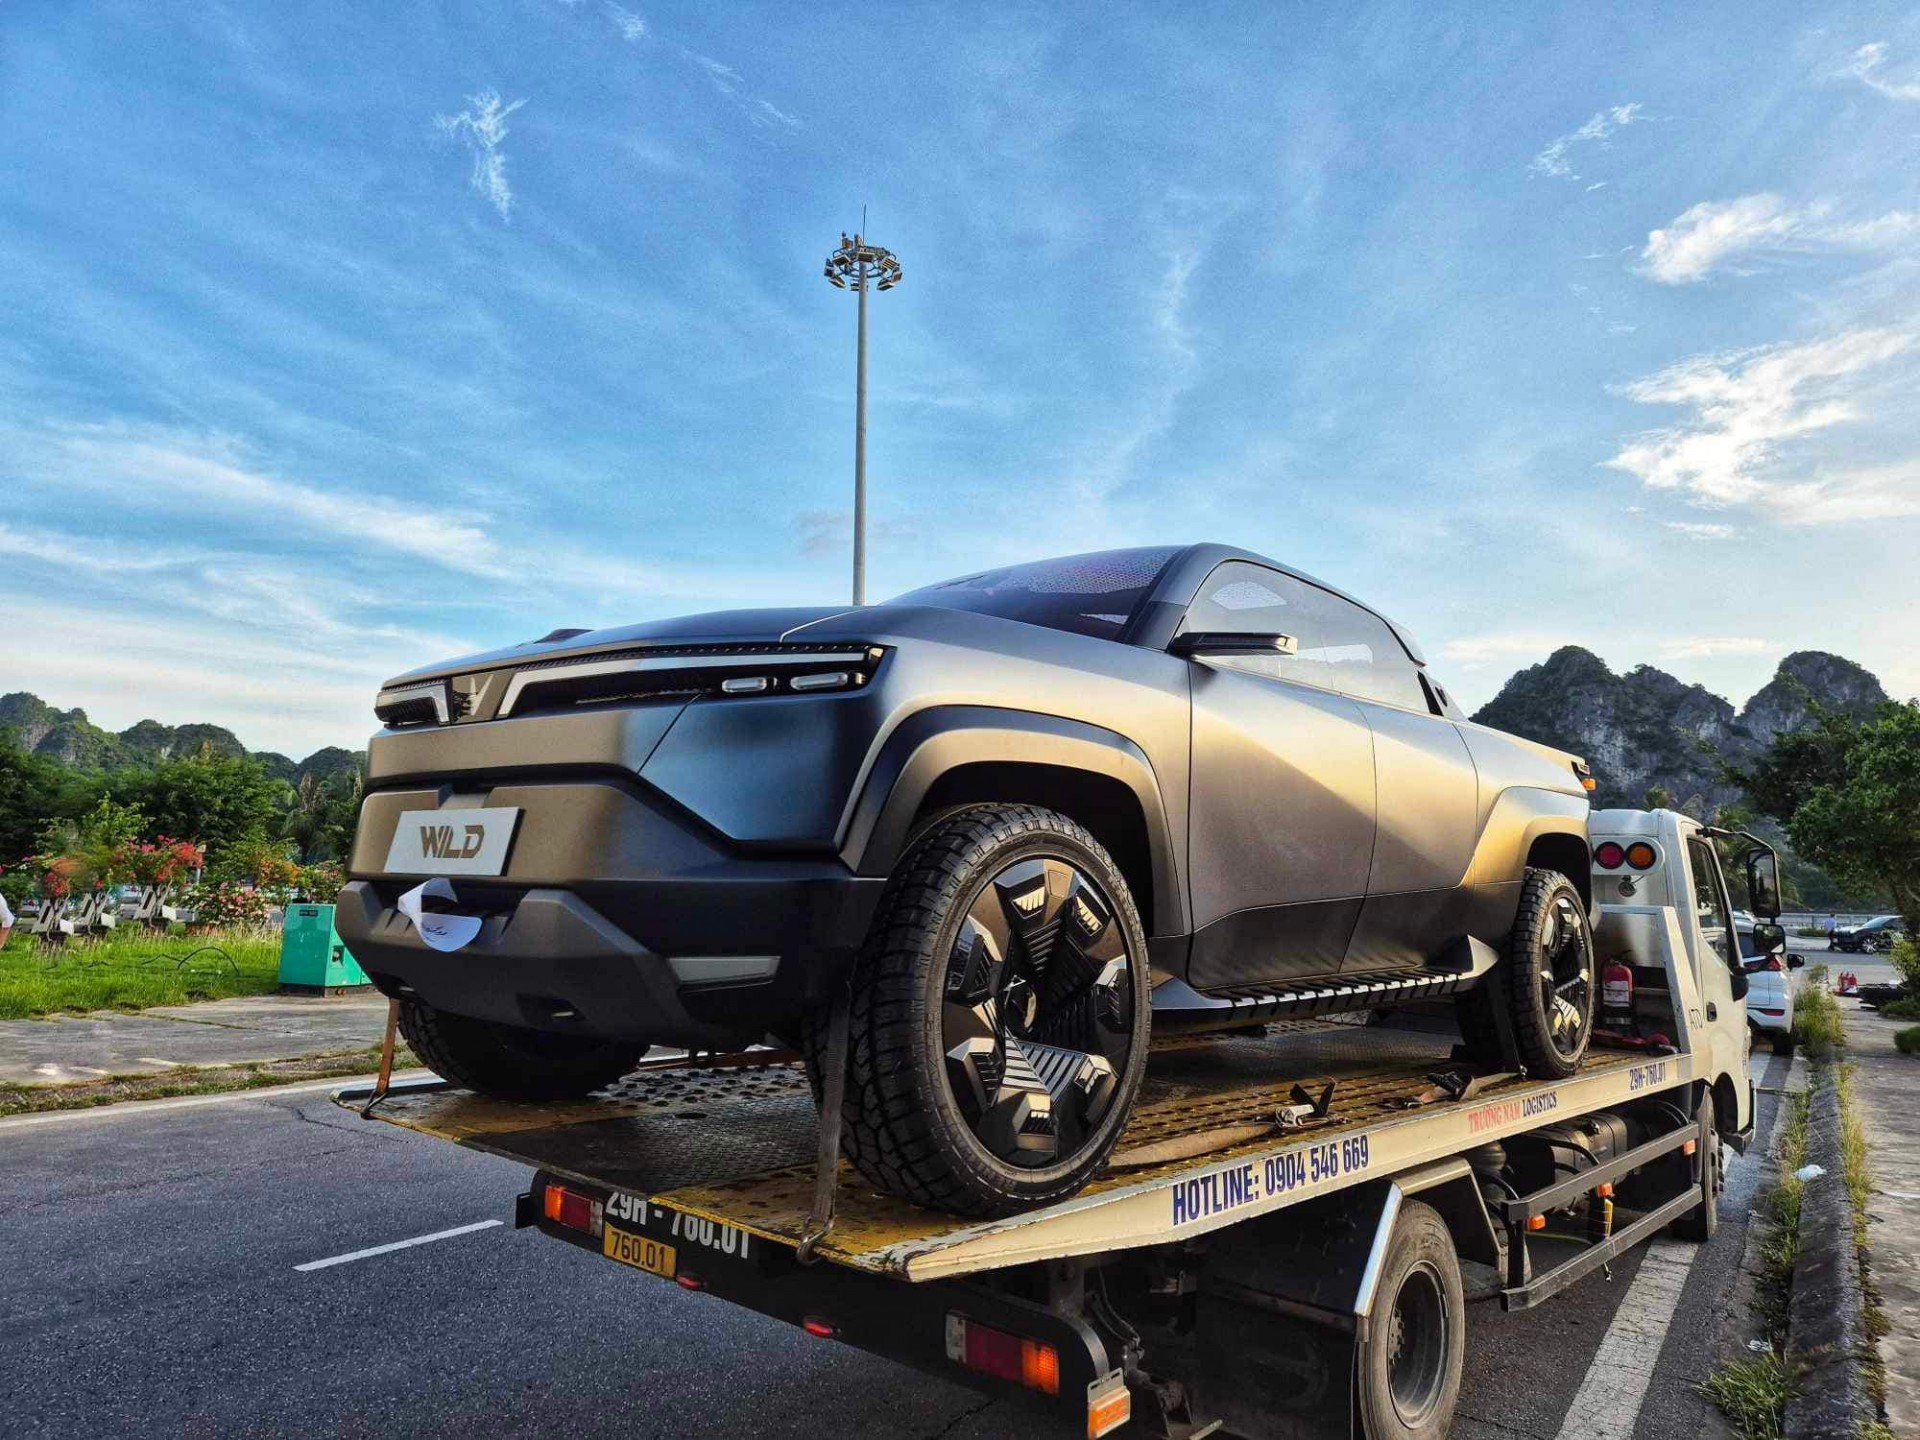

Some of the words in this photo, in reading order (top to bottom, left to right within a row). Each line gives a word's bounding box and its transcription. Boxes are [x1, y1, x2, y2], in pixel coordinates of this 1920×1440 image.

[420, 824, 485, 859] WILD
[1629, 1062, 1666, 1091] 29H-760.01
[1503, 1101, 1521, 1123] NAM
[1522, 1091, 1558, 1117] LOGISTICS
[1172, 1164, 1260, 1226] HOTLINE:
[1265, 1151, 1306, 1196] 0904
[1310, 1141, 1339, 1183] 546
[1342, 1135, 1369, 1173] 669
[611, 1230, 665, 1272] 760.01
